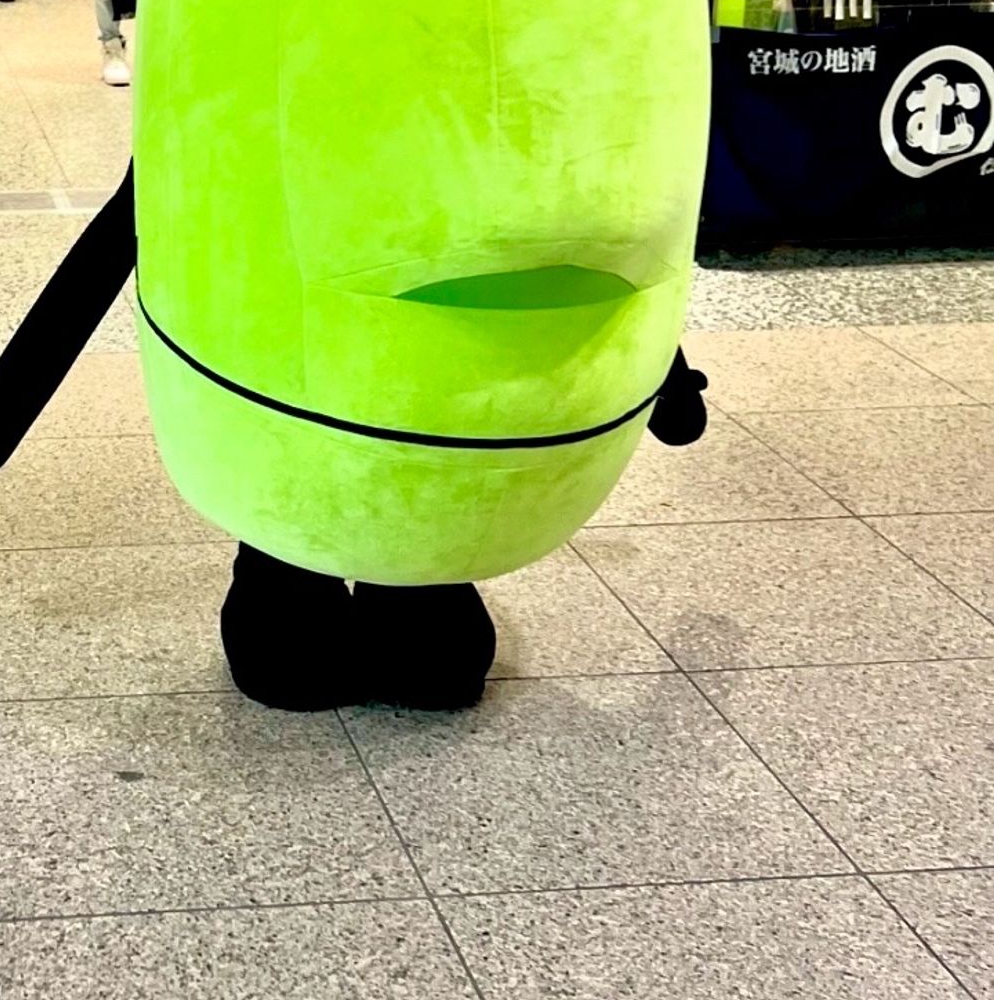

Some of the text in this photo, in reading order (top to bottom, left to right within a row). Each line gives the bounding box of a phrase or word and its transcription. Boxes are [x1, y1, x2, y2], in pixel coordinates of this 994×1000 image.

[748, 45, 877, 76] 宮城の地酒
